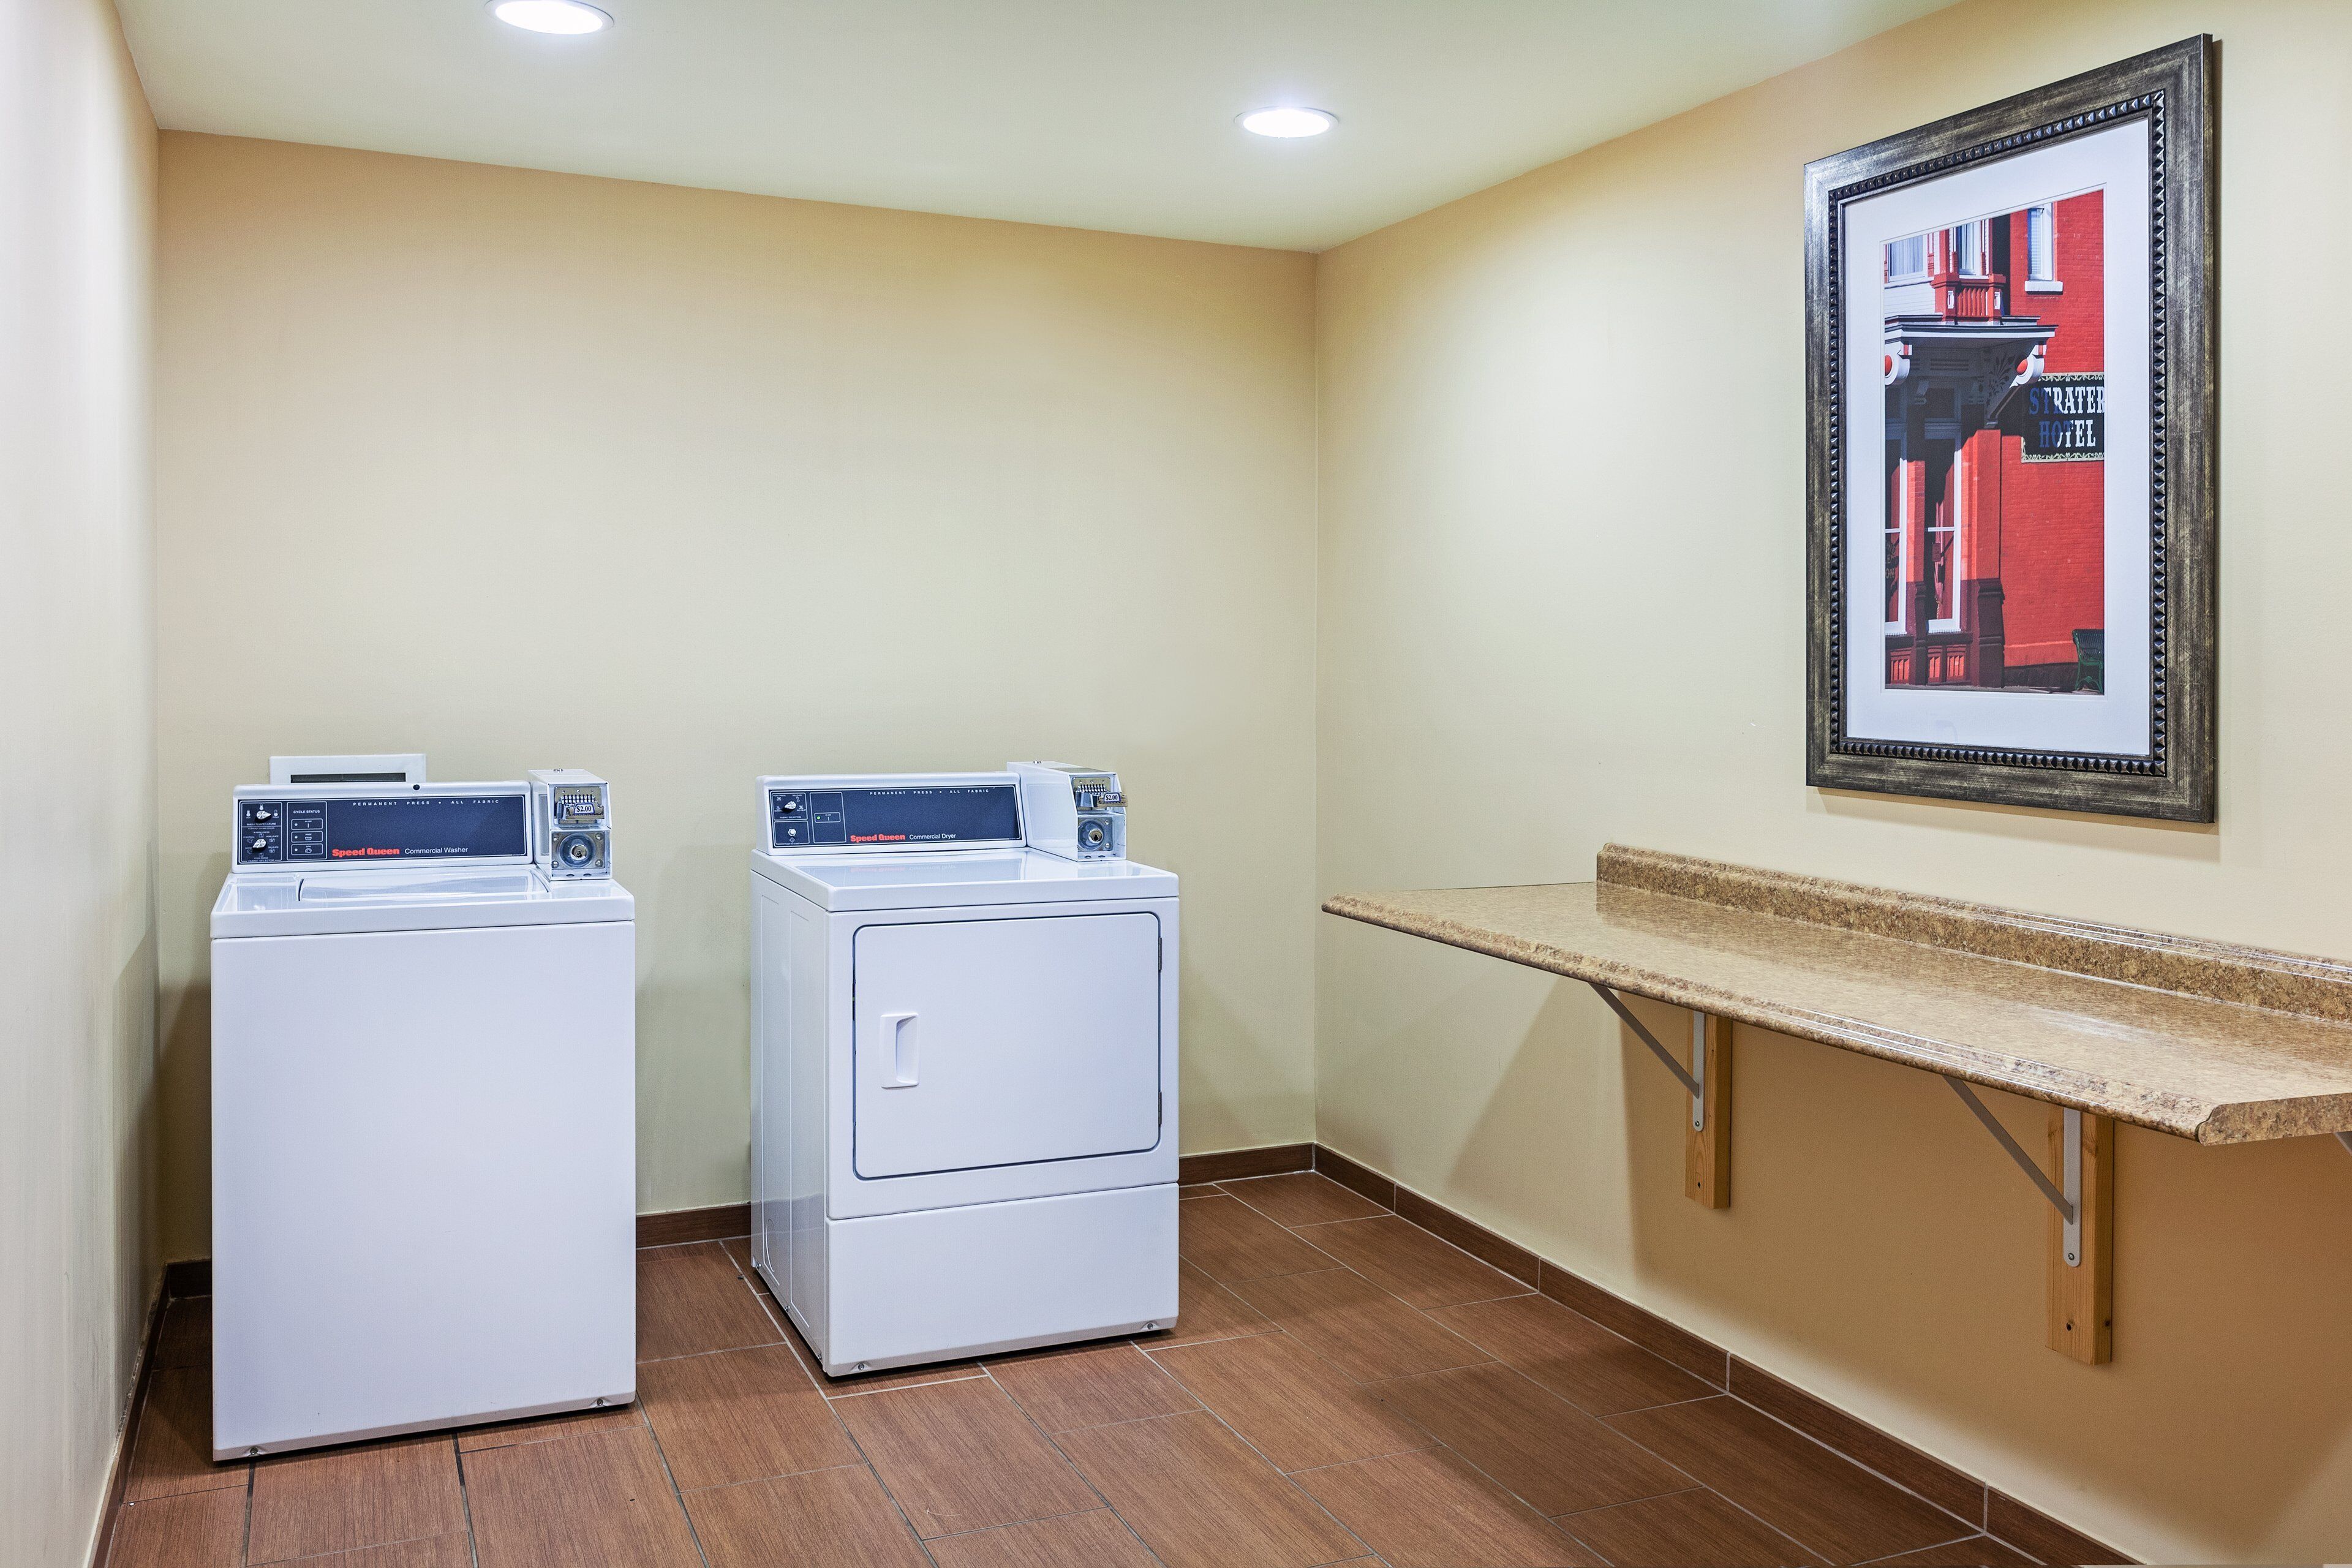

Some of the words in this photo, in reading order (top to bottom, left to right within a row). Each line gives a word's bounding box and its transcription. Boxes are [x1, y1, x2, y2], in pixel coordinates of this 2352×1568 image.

[2029, 386, 2105, 415] STRATER
[2038, 419, 2096, 448] HOTEL
[850, 834, 877, 843] Speed
[332, 848, 365, 858] Speed
